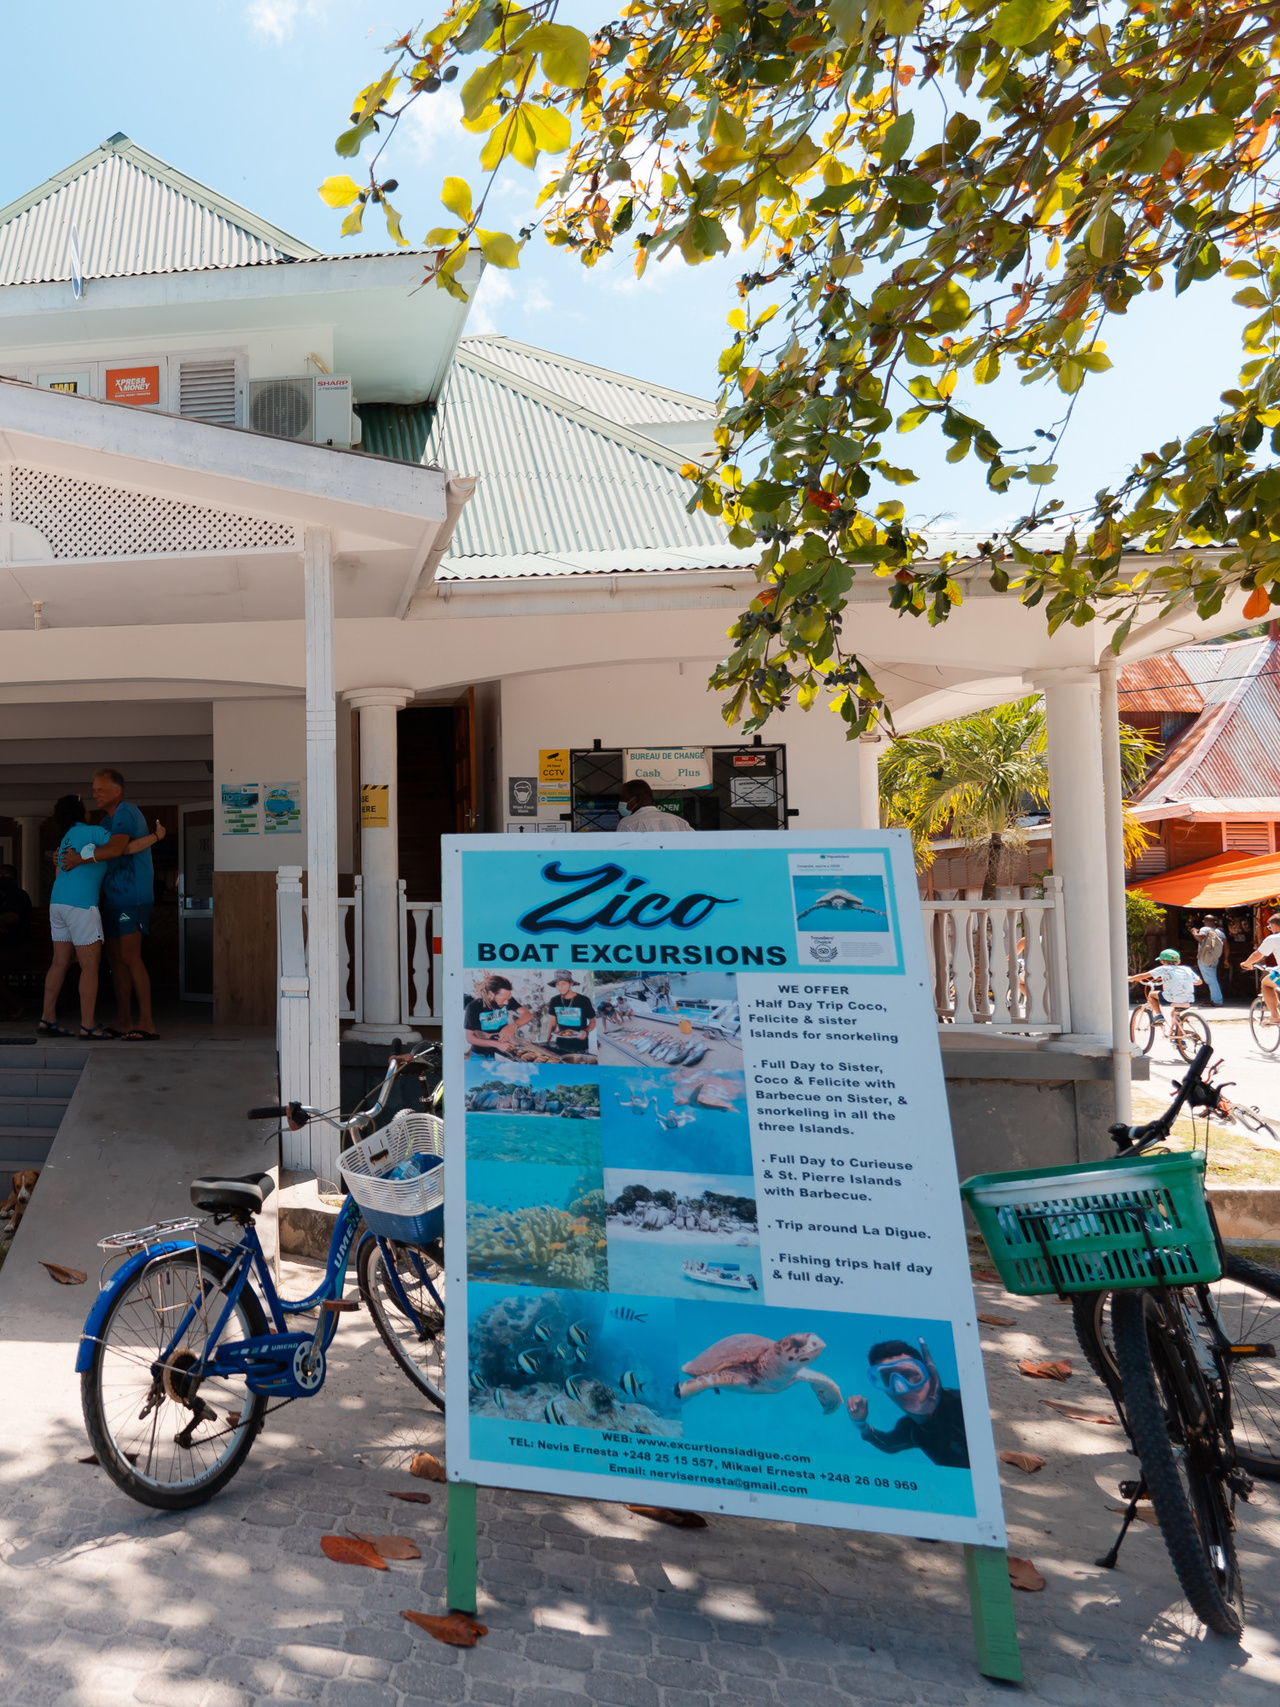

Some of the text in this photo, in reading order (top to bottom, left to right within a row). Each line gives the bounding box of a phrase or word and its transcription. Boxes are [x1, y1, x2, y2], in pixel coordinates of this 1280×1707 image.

[115, 377, 146, 386] XPRESS
[123, 383, 150, 391] MONEY
[630, 752, 705, 760] BUREAU DE CHANGE
[635, 768, 700, 778] Cash Plus
[362, 805, 376, 813] ERE
[657, 803, 680, 812] OPEN
[518, 861, 740, 934] Zico
[477, 943, 787, 965] BOAT EXCURSIONS
[778, 984, 849, 995] WE OFFER
[755, 999, 887, 1013] Half Day Trip Coco,
[749, 1014, 857, 1026] Felicite & sister
[750, 1029, 899, 1044] Islands for snorkeling
[761, 1059, 883, 1074] Full Day to Sister,
[754, 1075, 896, 1089] Coco & Felicite with
[755, 1090, 908, 1106] Barbecue on Sister, &
[757, 1106, 896, 1121] snorkeling in all the
[758, 1121, 855, 1135] three Islands.
[769, 1153, 913, 1171] Full Day to Curieuse
[763, 1169, 902, 1187] & St. Pierre Islands
[764, 1186, 872, 1202] with Barbecue.
[775, 1219, 932, 1240] Trip around La Digue.
[334, 1223, 354, 1268] UME
[779, 1253, 933, 1276] Fishing trips half day
[772, 1269, 844, 1286] & full day.
[601, 1432, 811, 1463] WEB: www.excurtionsladigue.com
[508, 1436, 918, 1491] TEL: Nevis Ernesta +248 25 15 557, Mikael Ernesta +248 26 08 969
[609, 1463, 808, 1495] Email: nervisernesta@gmail.com
